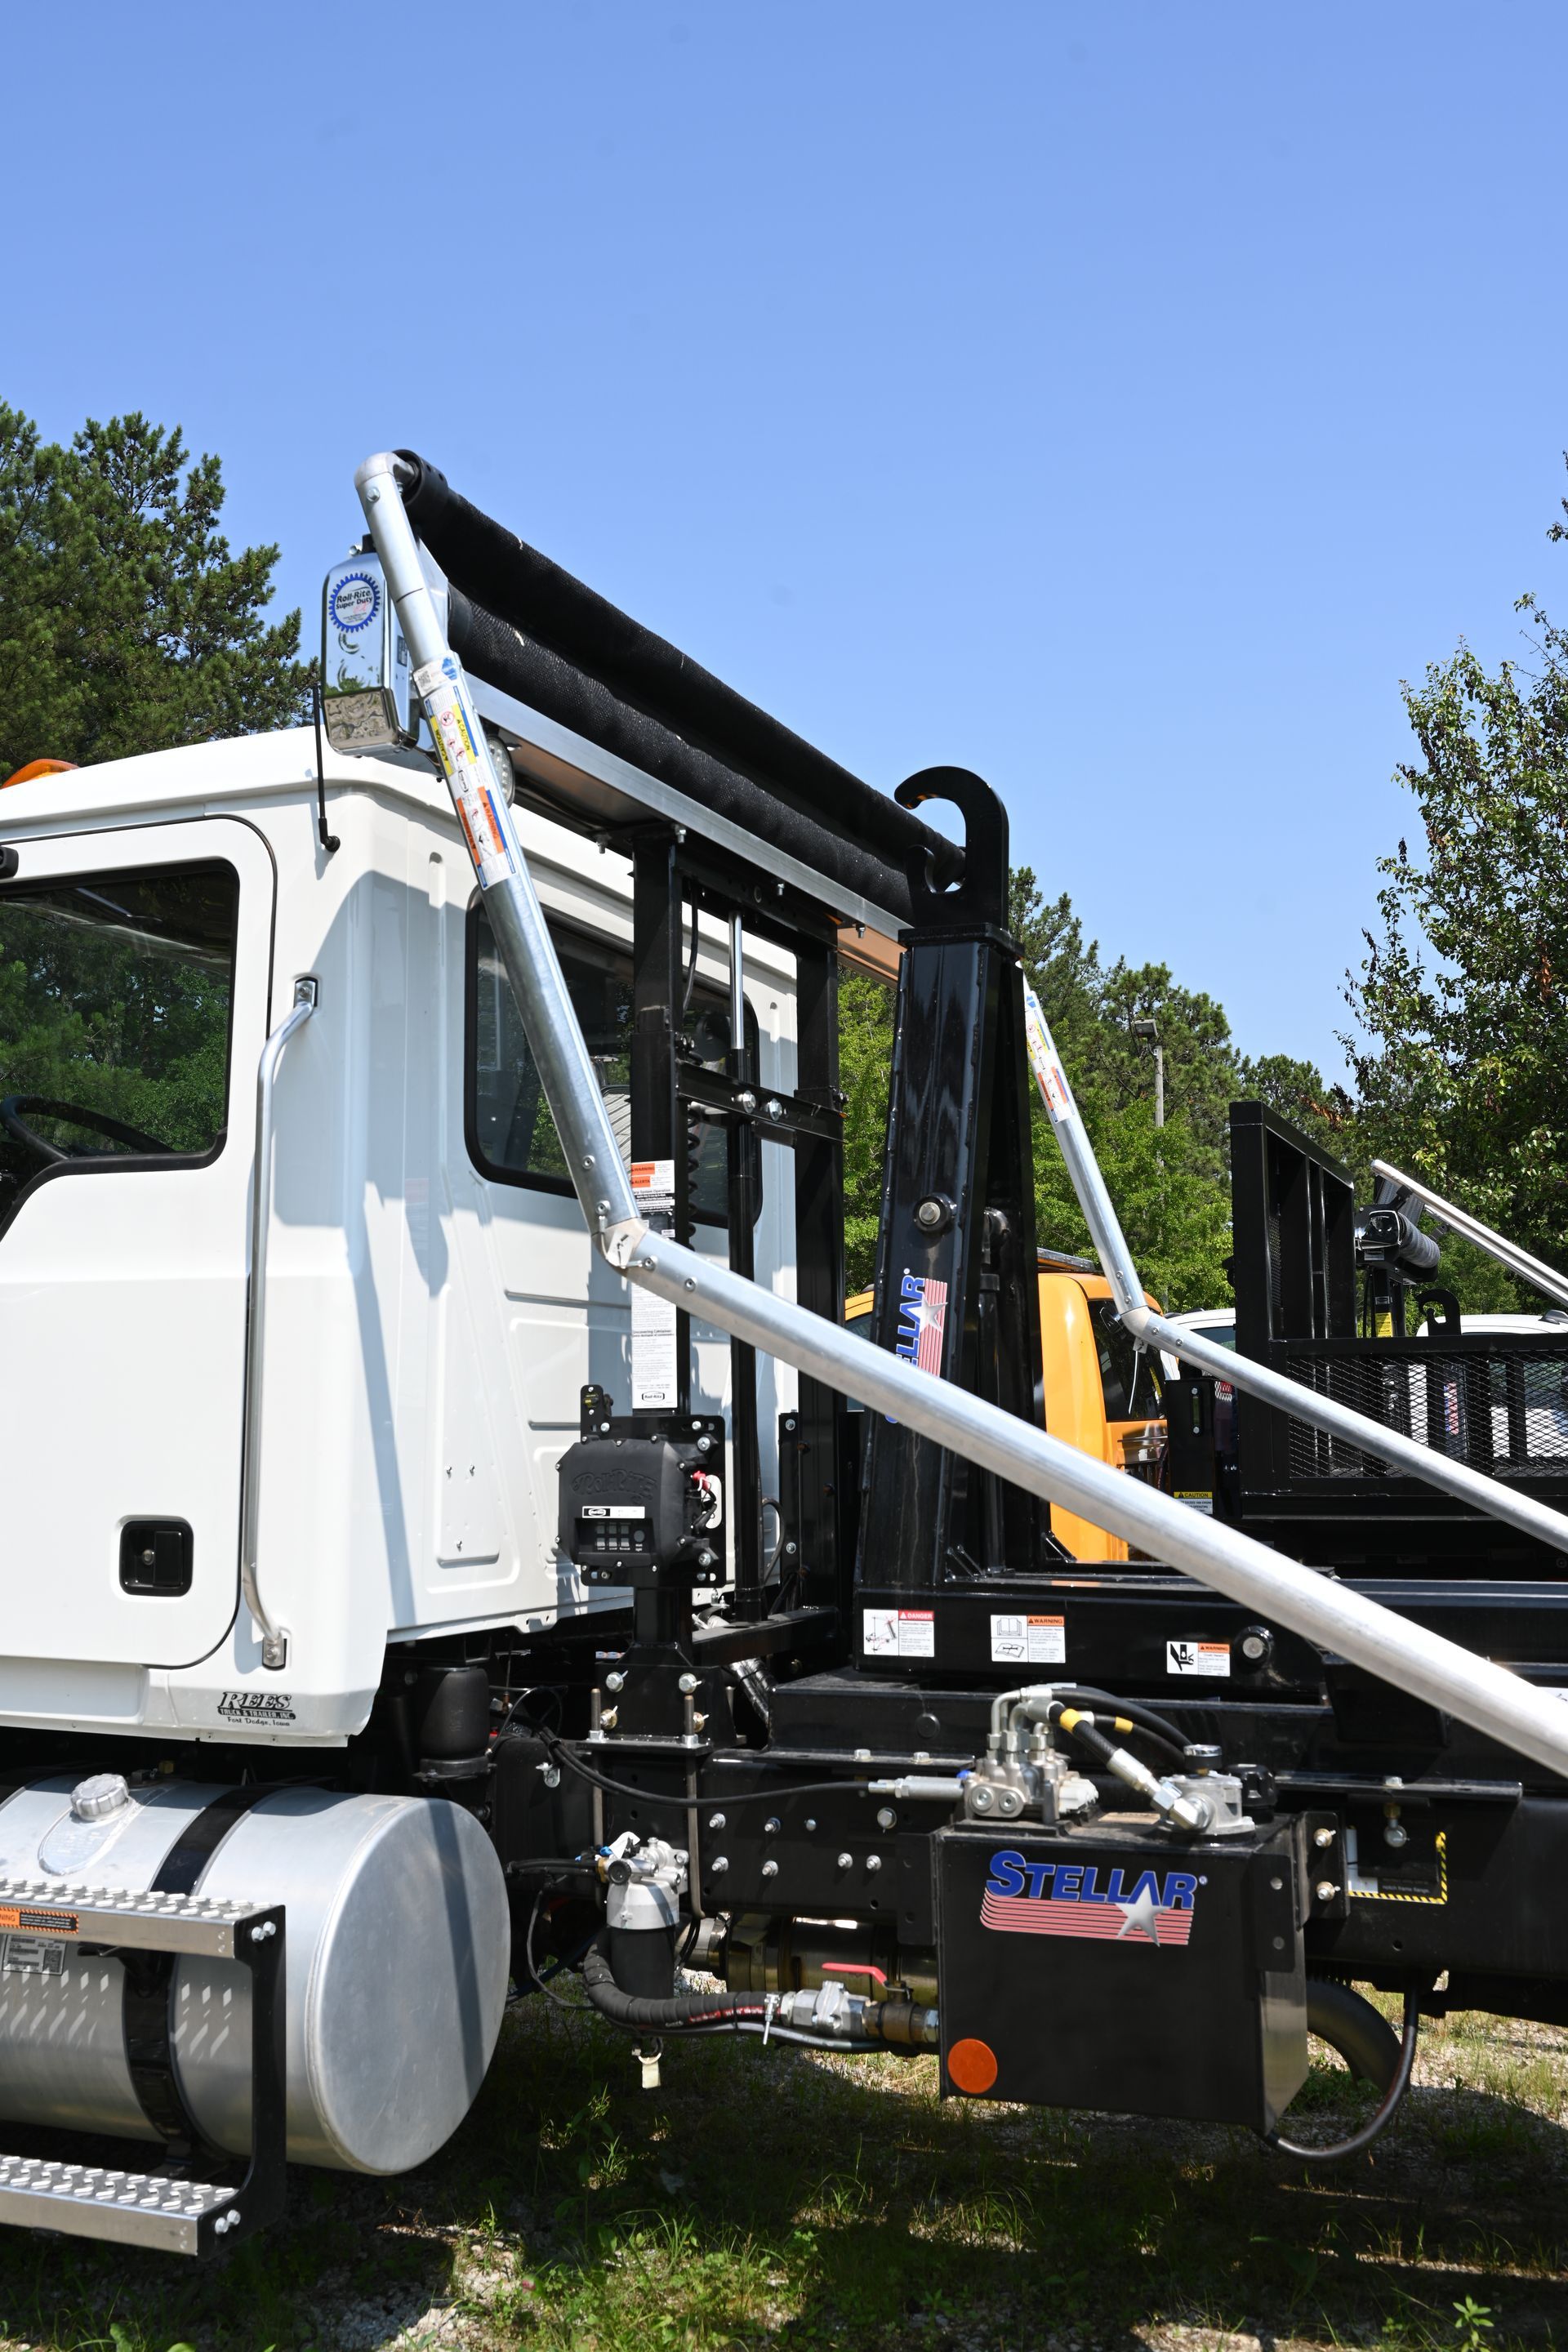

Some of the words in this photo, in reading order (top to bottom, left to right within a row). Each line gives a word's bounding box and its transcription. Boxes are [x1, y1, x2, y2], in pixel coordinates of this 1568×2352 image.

[336, 600, 354, 609] Super
[356, 596, 372, 605] Duty
[435, 729, 448, 759] CAUTION
[457, 724, 471, 751] CAUTION
[484, 805, 498, 840] WARNING
[218, 1691, 292, 1710] REES
[986, 1850, 1198, 1909] STELLAR
